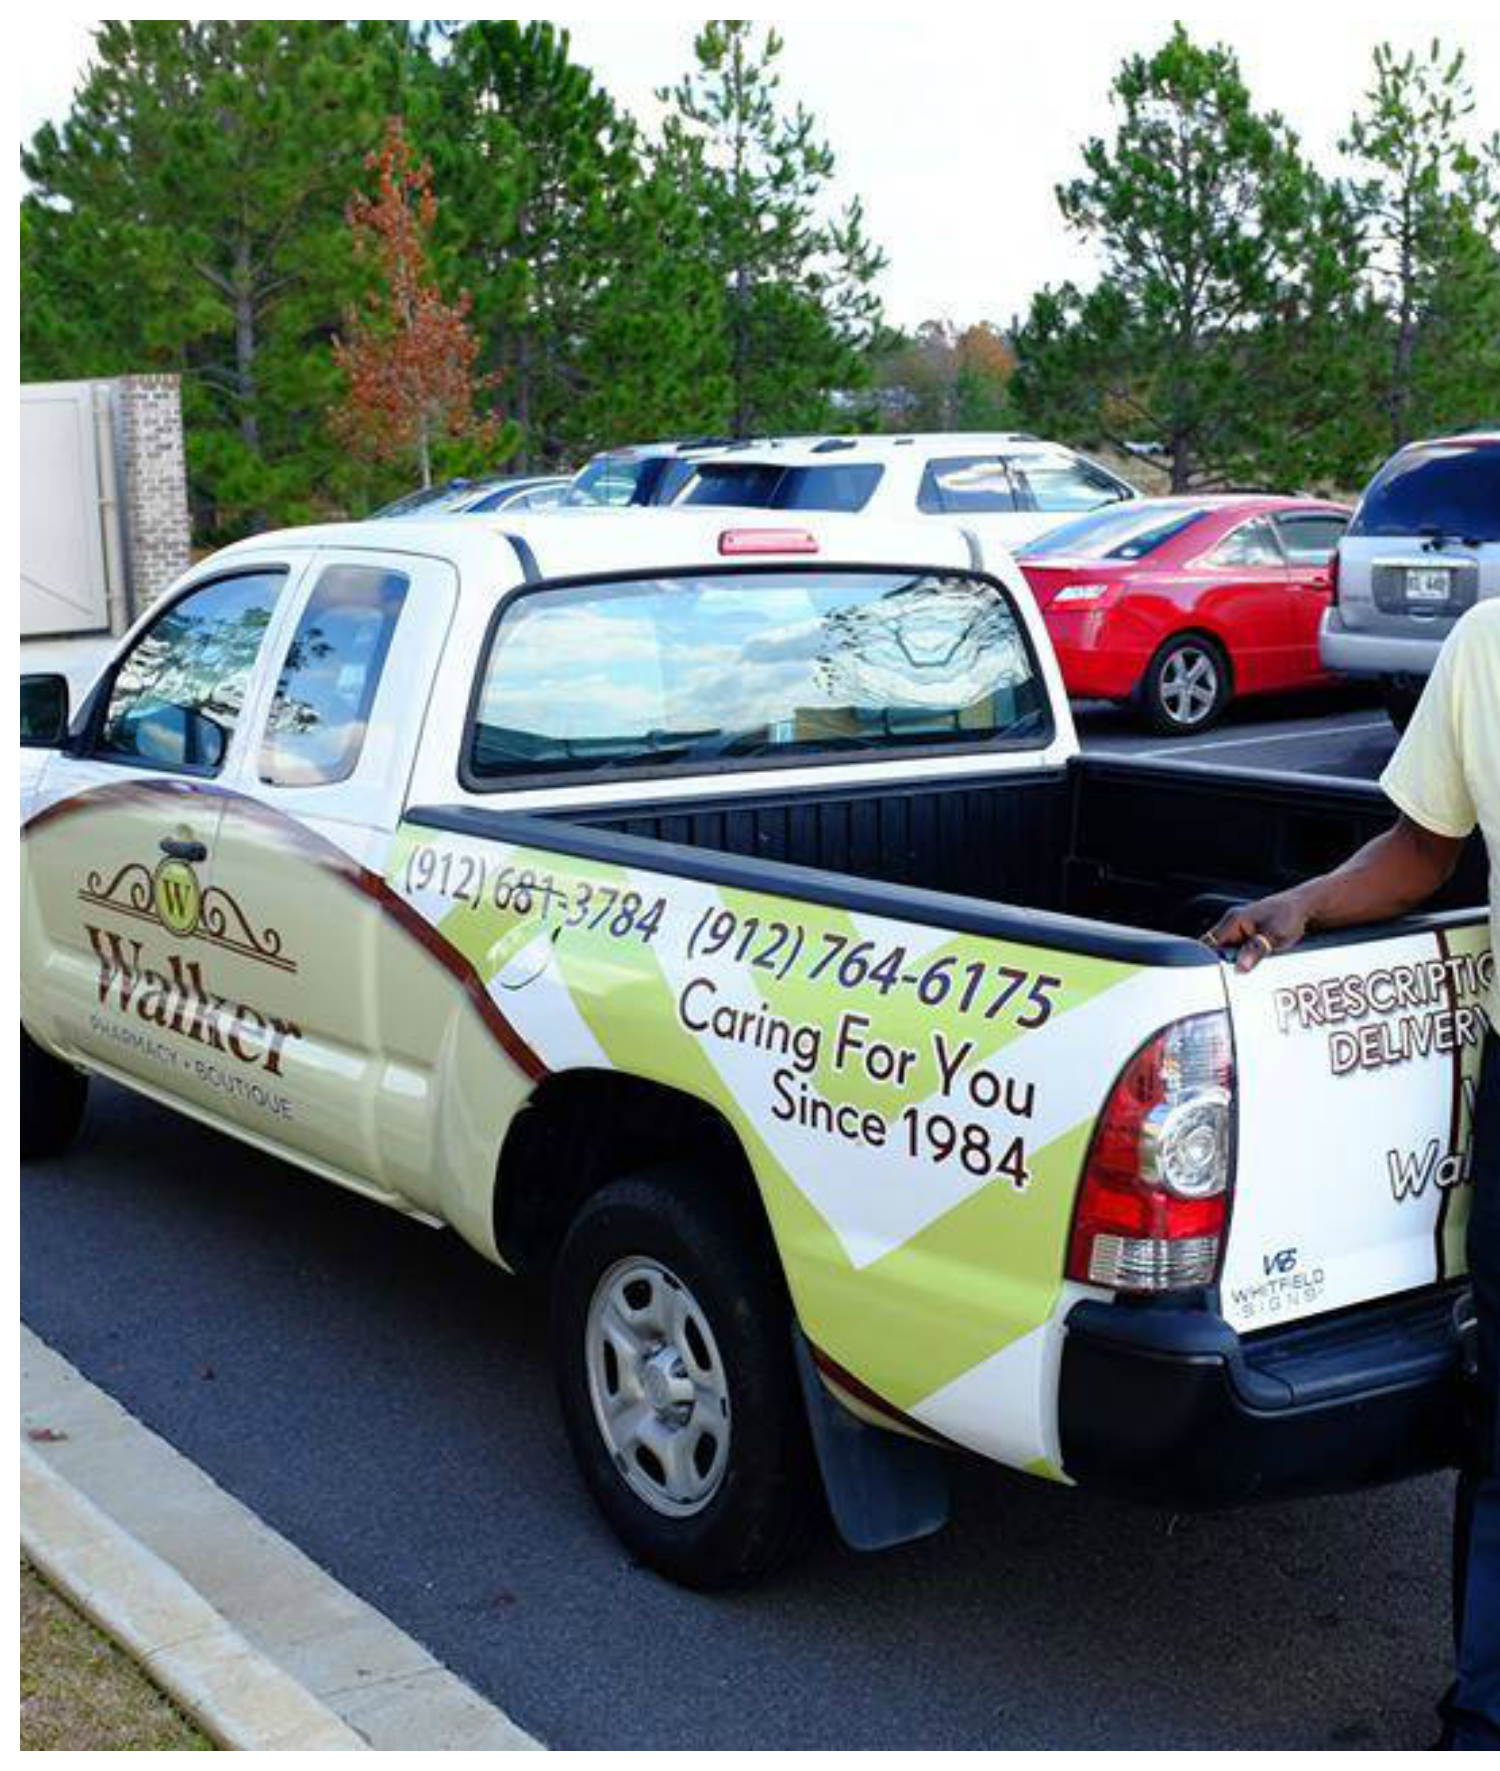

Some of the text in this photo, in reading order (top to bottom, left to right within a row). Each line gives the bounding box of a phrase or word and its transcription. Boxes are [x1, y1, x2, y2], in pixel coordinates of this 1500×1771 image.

[162, 878, 191, 918] W
[405, 845, 668, 944] (912) 681-3784
[85, 924, 303, 1078] Walker
[686, 904, 1062, 1030] (912) 764-6175
[90, 1014, 294, 1121] PHARMACY BOUTIQUE
[678, 977, 1037, 1119] Caring For You
[771, 1069, 1030, 1188] Since 1984
